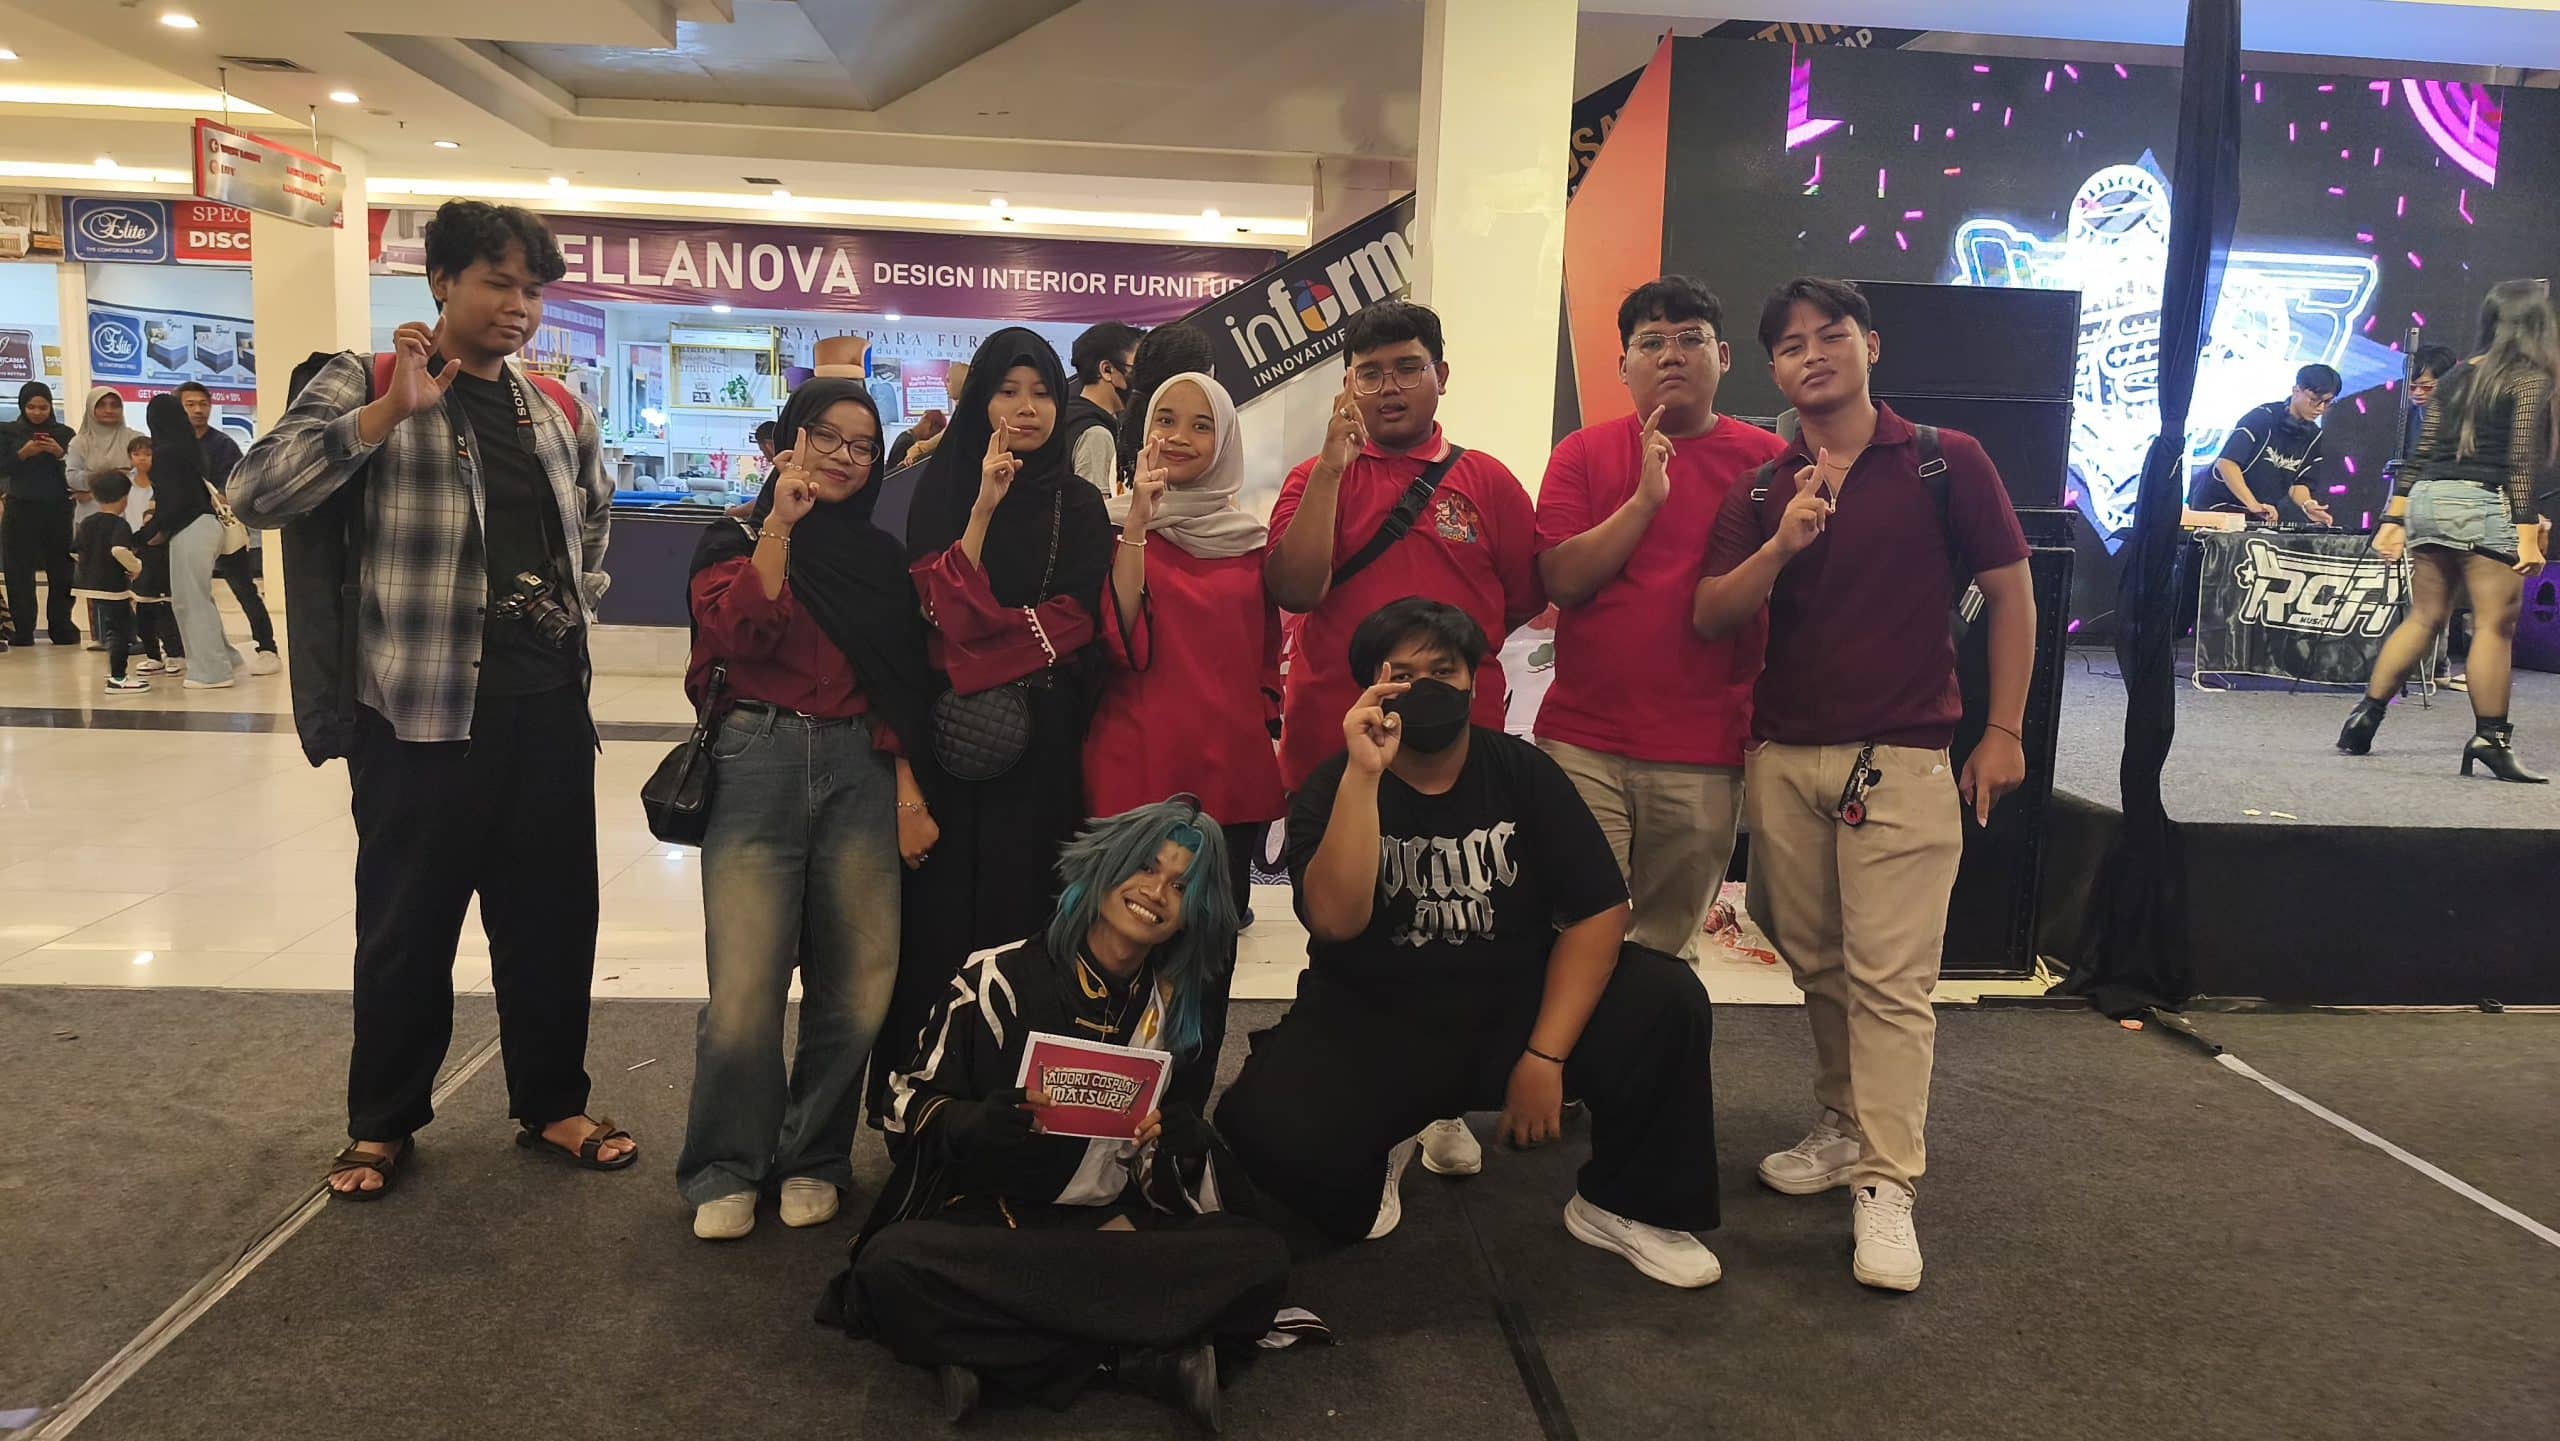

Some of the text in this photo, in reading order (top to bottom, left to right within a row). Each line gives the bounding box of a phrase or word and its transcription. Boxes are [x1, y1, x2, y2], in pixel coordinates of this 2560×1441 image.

[90, 212, 147, 239] Elite
[189, 231, 250, 249] DISC
[873, 262, 974, 288] DESIGN
[982, 267, 1107, 295] INTERIOR
[99, 325, 133, 355] Elite
[509, 379, 527, 416] SONY
[1046, 1069, 1139, 1094] AIDORU COSPLAY
[1052, 1086, 1126, 1109] MATSURI
